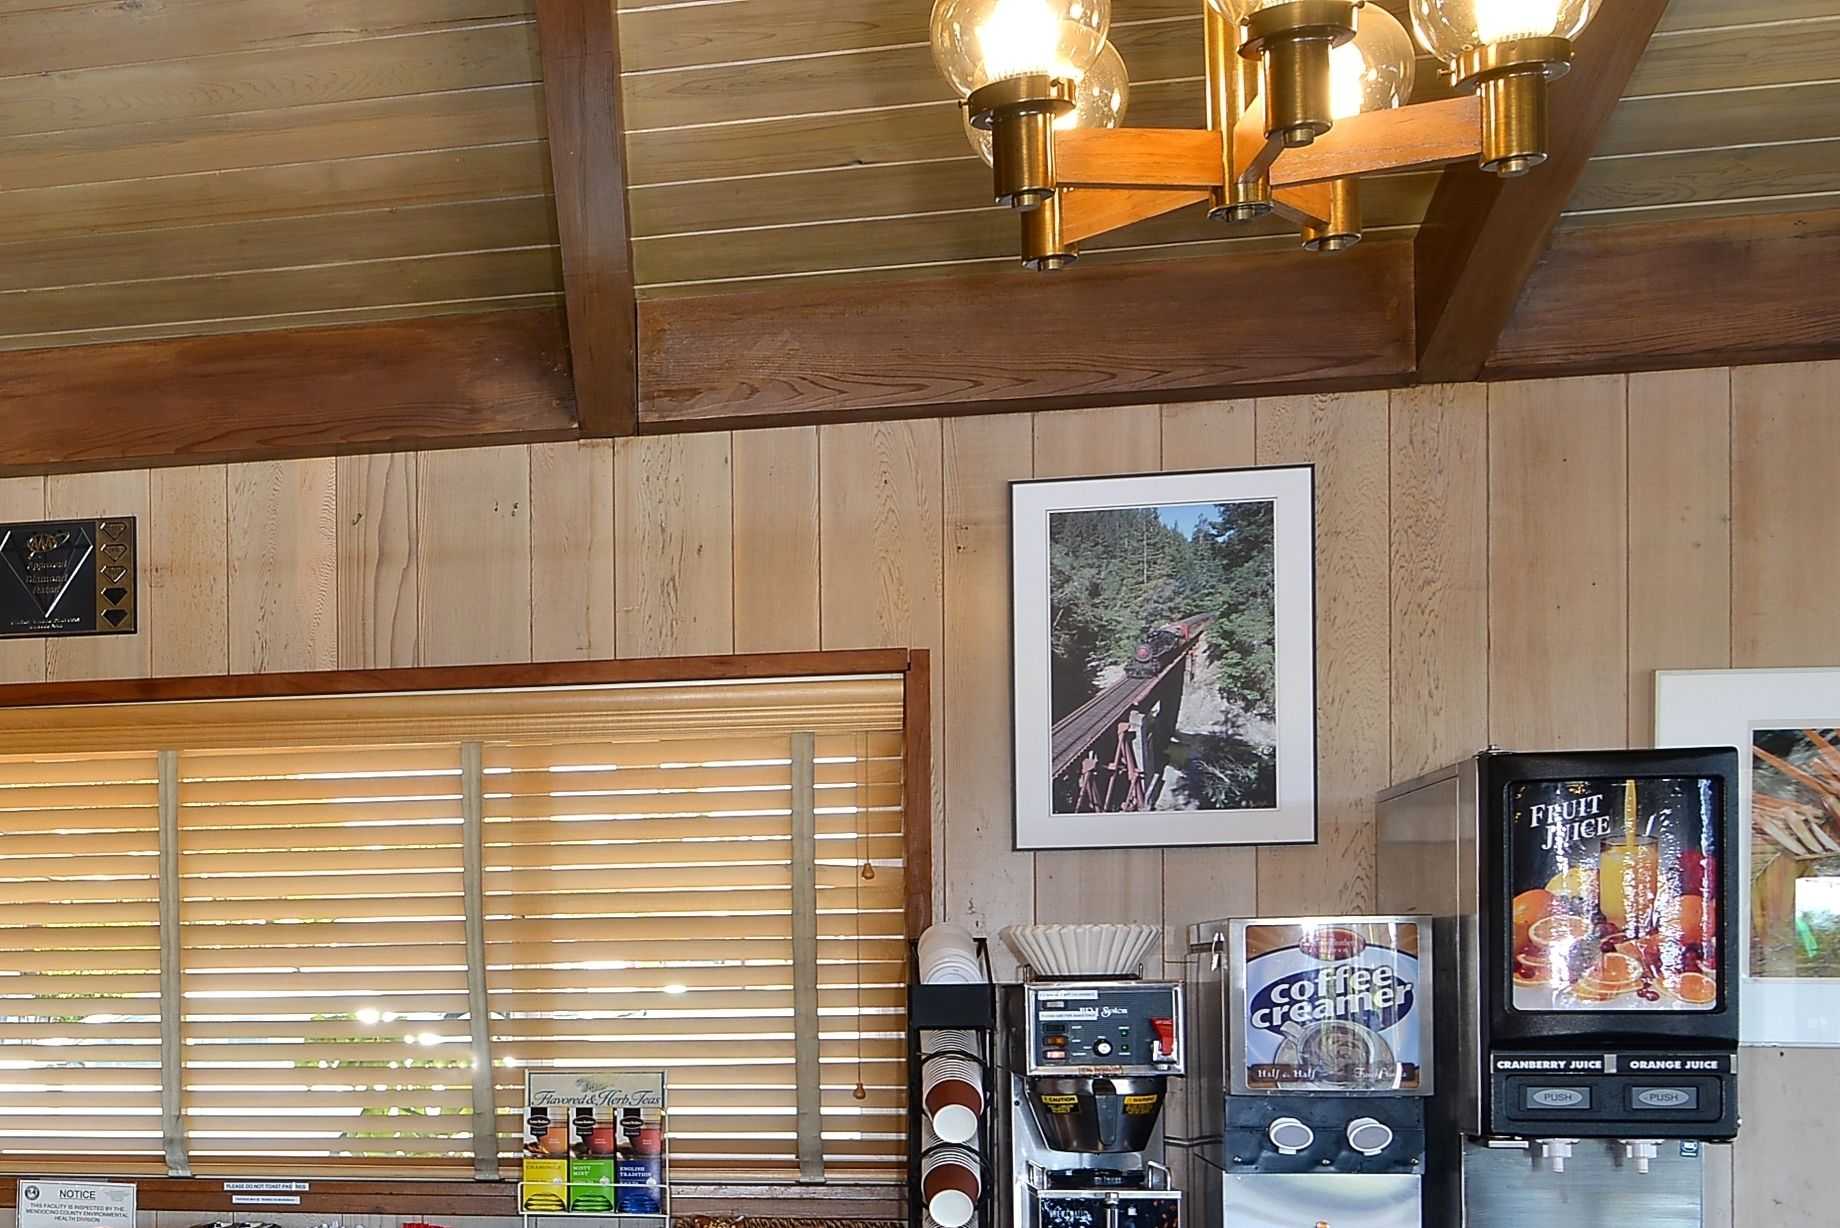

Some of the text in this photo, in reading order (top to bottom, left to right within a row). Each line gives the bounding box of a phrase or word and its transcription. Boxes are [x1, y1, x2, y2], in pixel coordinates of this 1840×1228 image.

[1530, 794, 1603, 828] FRUIT
[1541, 815, 1610, 850] JUICE
[1270, 964, 1393, 1004] coffee
[1251, 983, 1413, 1029] creamer
[1496, 1060, 1602, 1070] CRANBERRY JUICE
[1630, 1061, 1718, 1070] ORANGE JUICE
[532, 1090, 660, 1106] Flavored & Herb Teas
[1544, 1093, 1572, 1101] PUSH
[1649, 1093, 1678, 1101] PUSH
[59, 1189, 96, 1200] NOTICE
